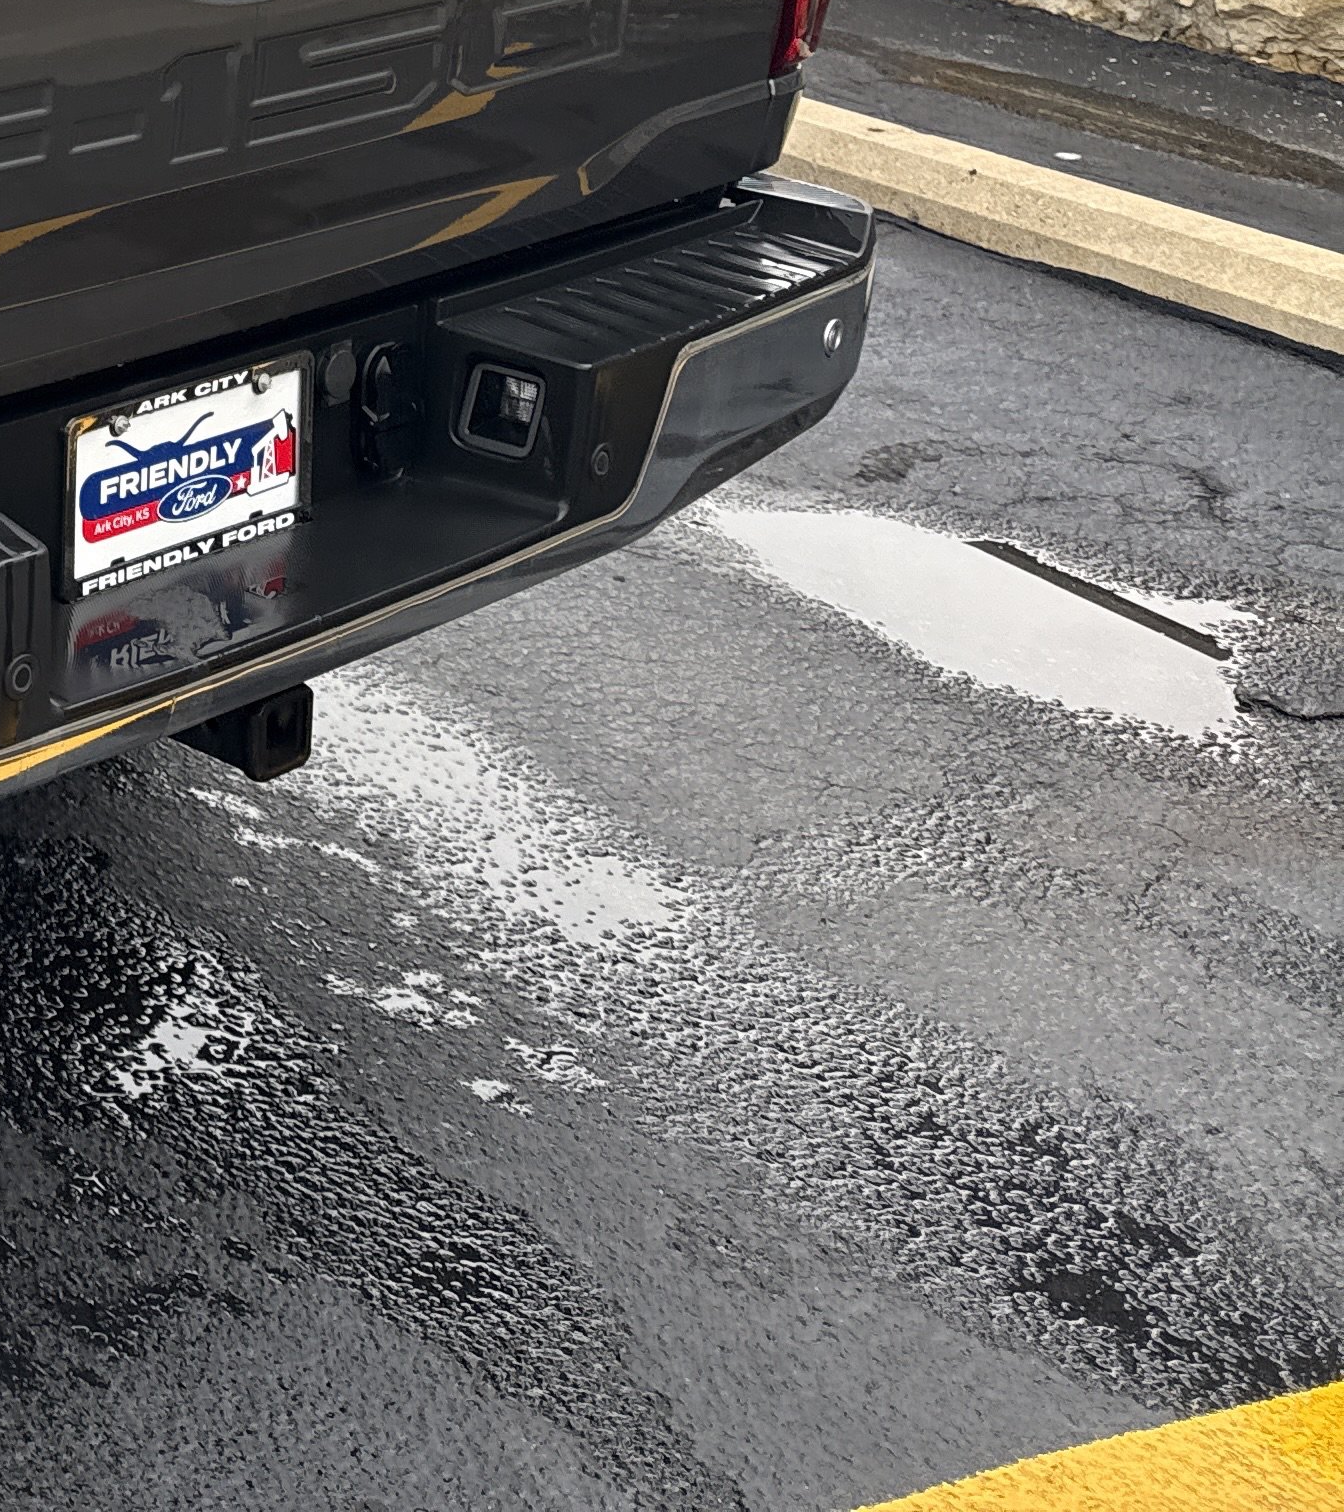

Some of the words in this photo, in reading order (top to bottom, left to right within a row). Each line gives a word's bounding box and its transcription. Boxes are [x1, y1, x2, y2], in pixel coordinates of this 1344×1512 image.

[136, 387, 188, 415] ARK
[194, 370, 249, 398] CITY
[99, 438, 243, 505] FRIENDLY
[93, 519, 112, 536] Ark
[135, 506, 150, 522] KS
[172, 486, 218, 517] Ford
[81, 538, 216, 597] FRIENDLY
[222, 511, 295, 548] FORD
